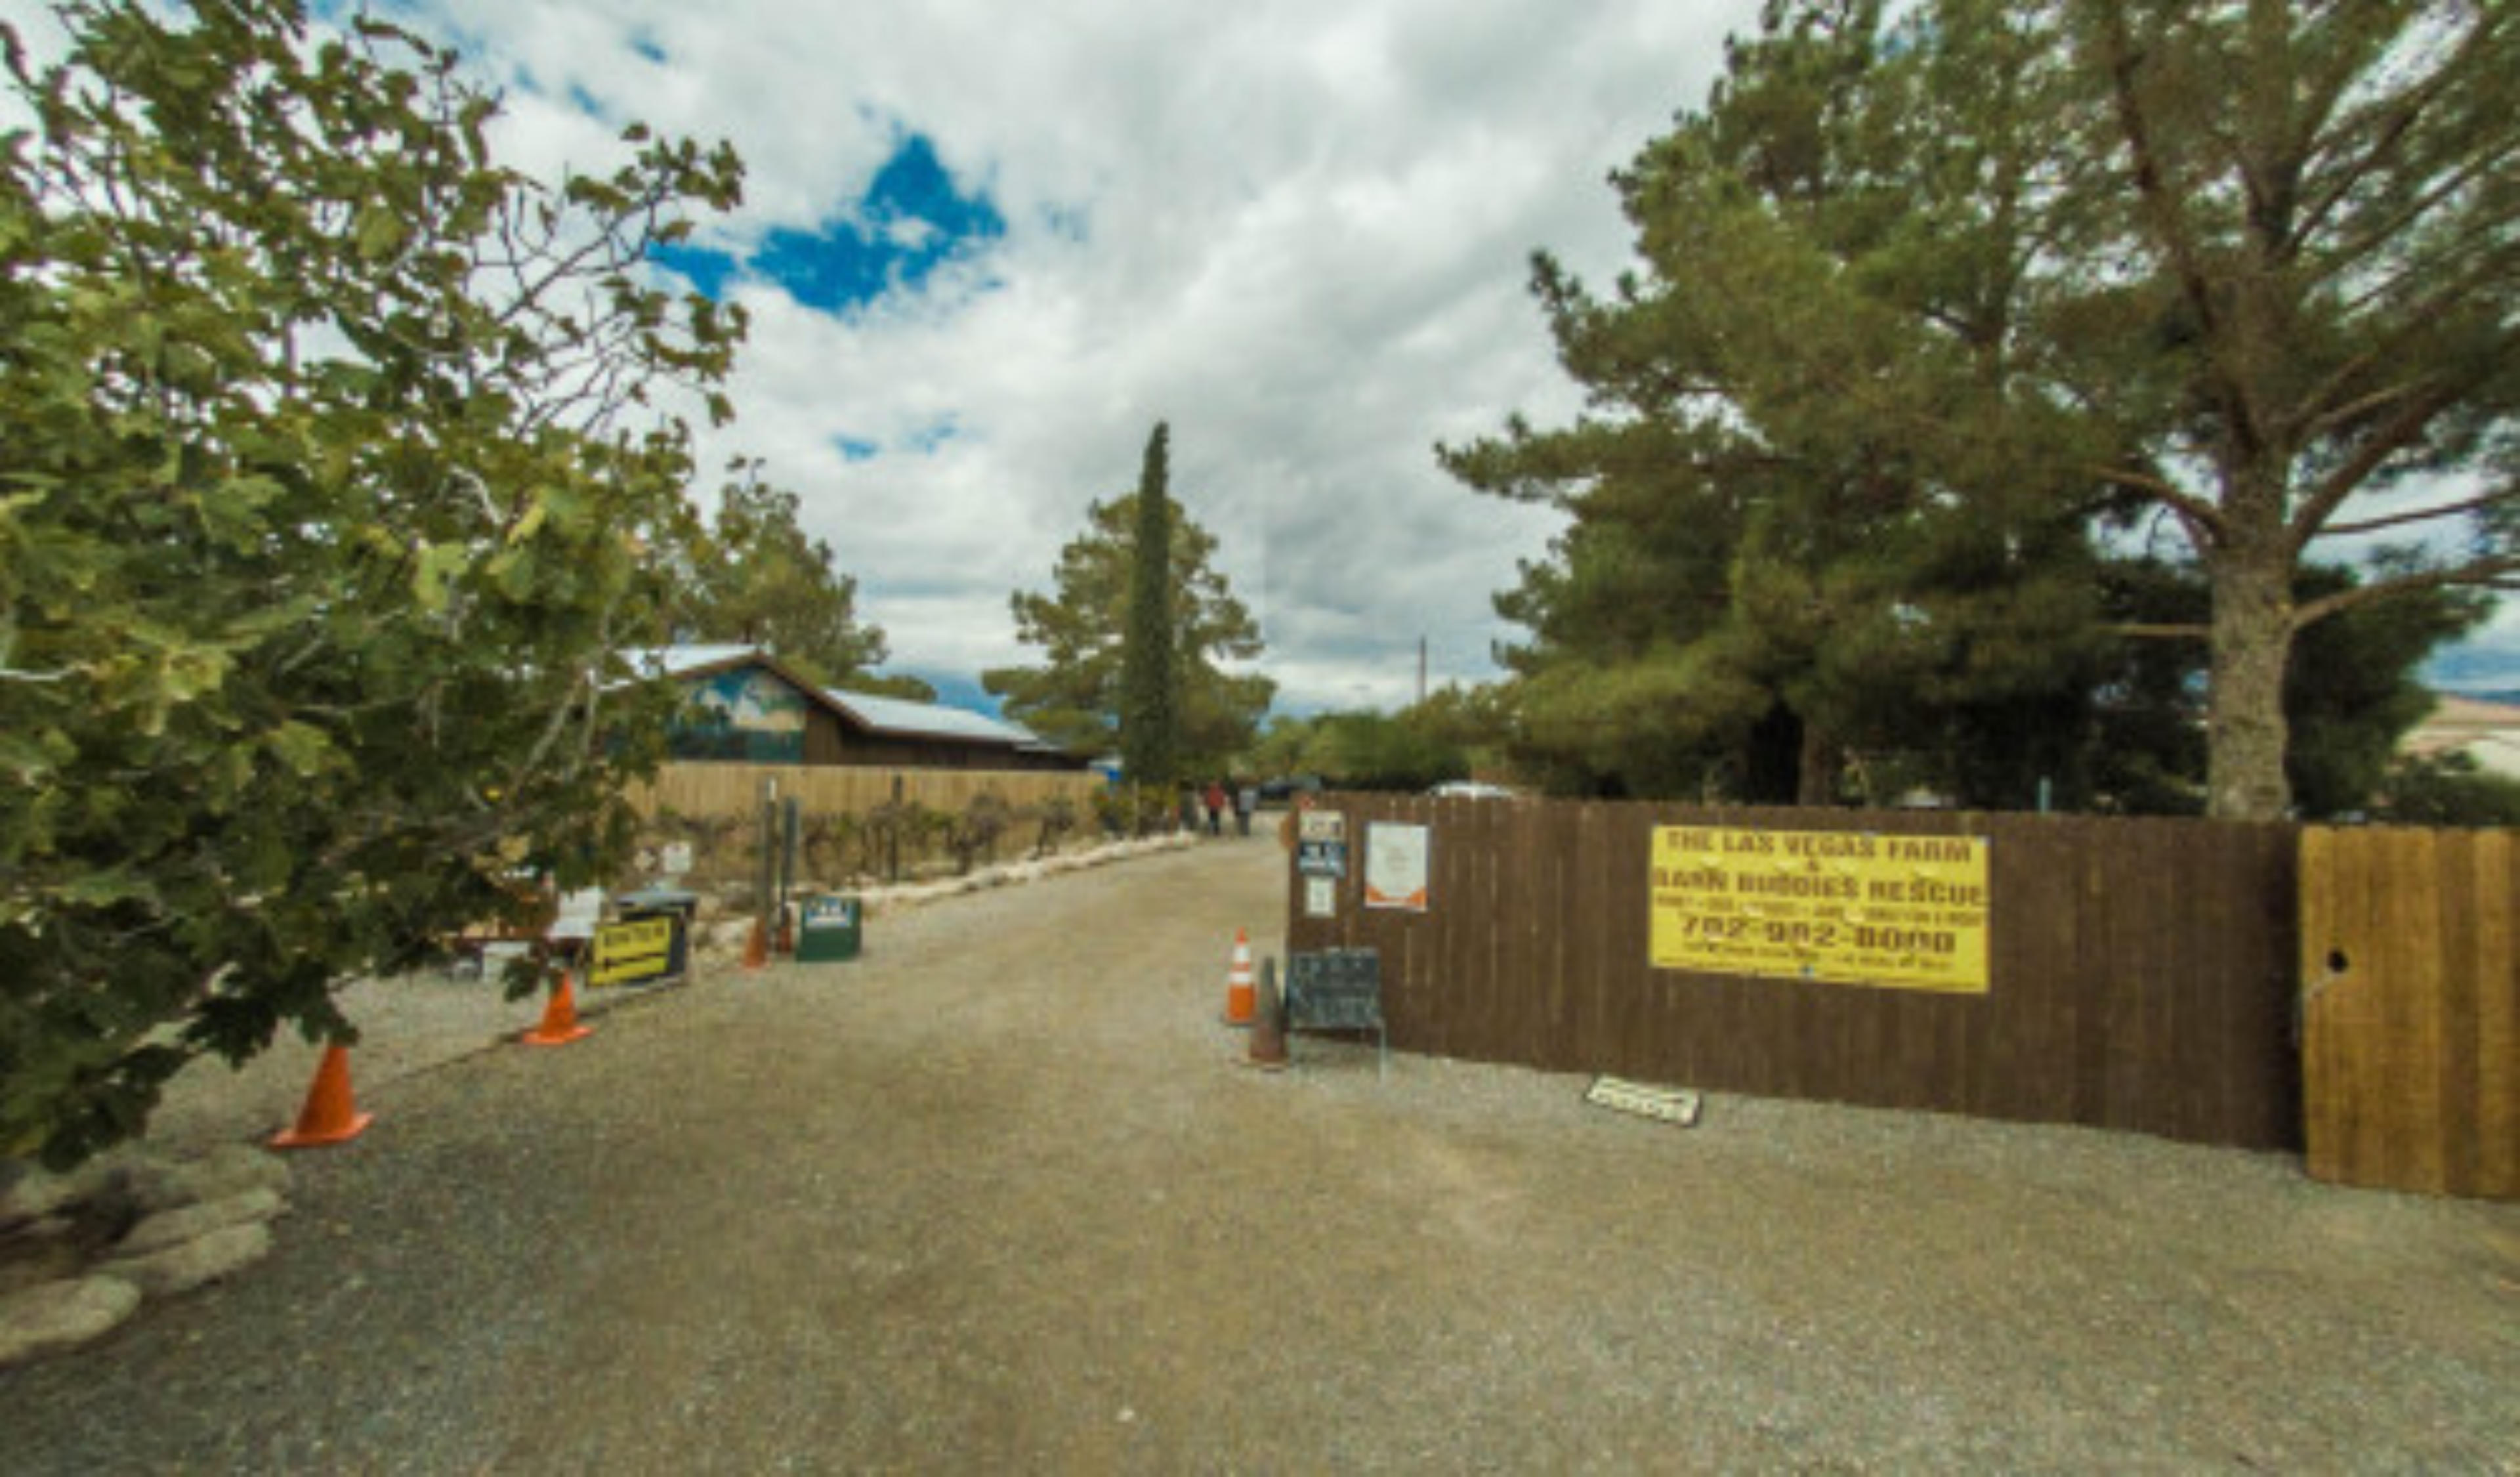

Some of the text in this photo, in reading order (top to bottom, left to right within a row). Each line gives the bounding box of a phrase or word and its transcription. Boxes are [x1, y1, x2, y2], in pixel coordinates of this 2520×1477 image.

[1668, 830, 1971, 863] THE LAS VEGAS FARM
[1653, 867, 1987, 907] BARN BUDDIES RESCUE
